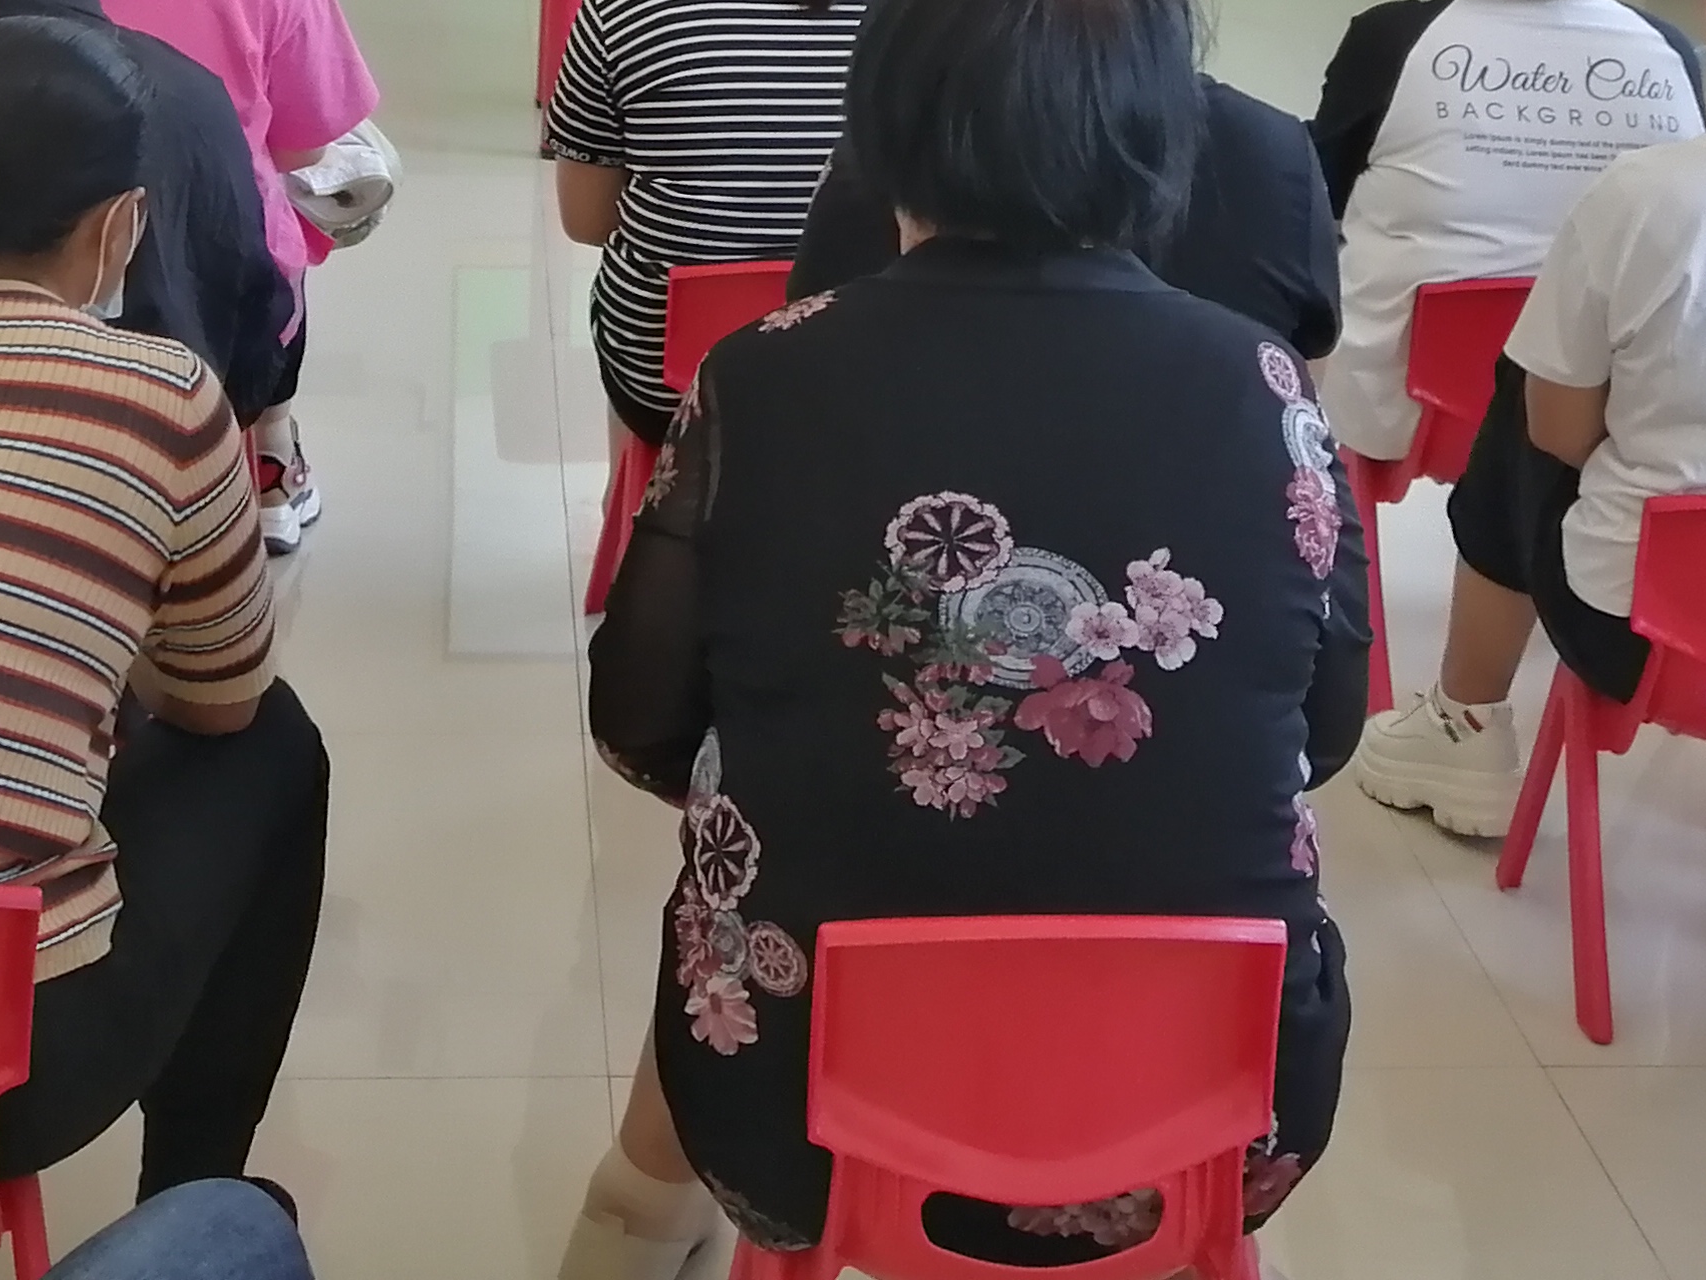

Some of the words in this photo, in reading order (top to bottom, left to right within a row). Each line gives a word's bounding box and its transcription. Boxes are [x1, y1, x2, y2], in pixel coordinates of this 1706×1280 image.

[1432, 44, 1573, 94] Water
[1586, 56, 1675, 102] Color
[1435, 100, 1680, 134] BACKGROUND
